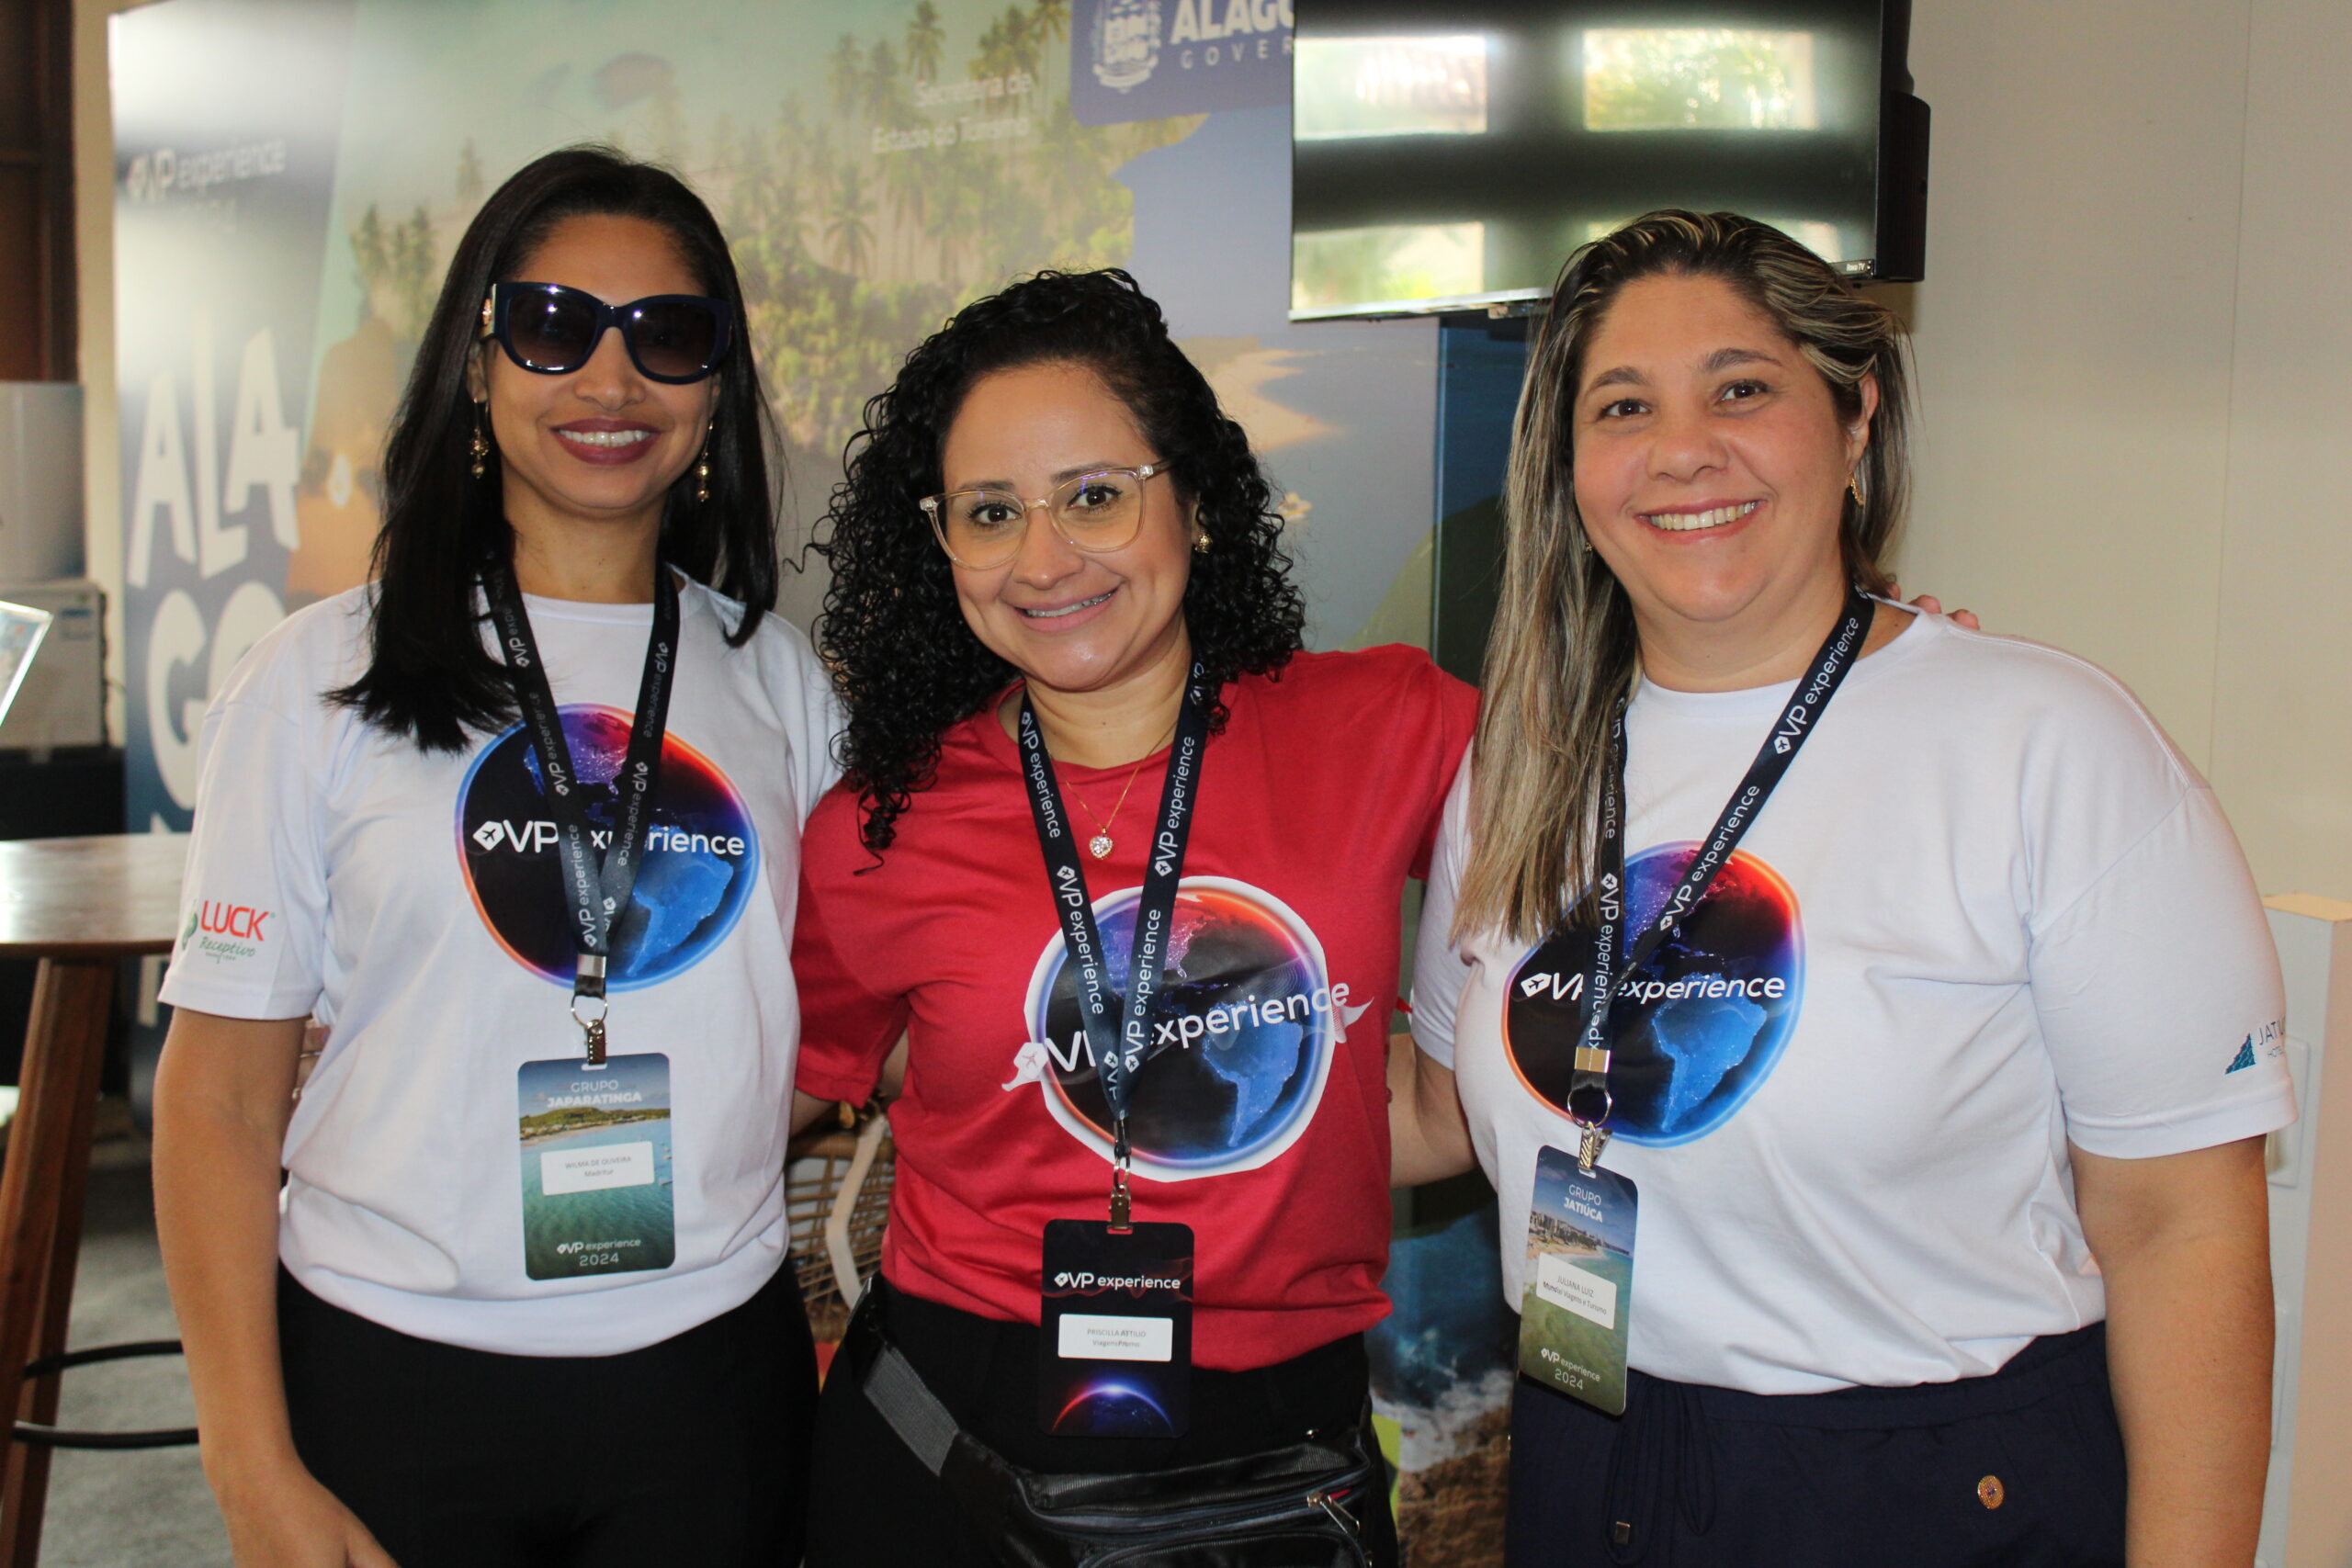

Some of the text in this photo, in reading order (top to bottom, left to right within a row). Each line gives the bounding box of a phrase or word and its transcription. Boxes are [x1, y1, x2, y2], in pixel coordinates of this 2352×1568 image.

[1779, 616, 1859, 737] VP experience
[643, 651, 669, 738] VP experience
[548, 762, 567, 785] VP
[1023, 719, 1060, 838] VP experience
[1157, 736, 1195, 863] VP experience
[617, 770, 649, 866] VP experience
[503, 819, 559, 853] VP
[1666, 784, 1759, 917] VP experience
[568, 824, 596, 935] VP experience
[1600, 888, 1619, 920] VP
[200, 899, 269, 942] LUCK
[199, 935, 256, 960] Receptivo
[1058, 876, 1103, 1014] VP experience
[1125, 909, 1161, 1055] VP experience
[1150, 982, 1351, 1049] xperience
[547, 1091, 642, 1109] JAPARATINGA
[571, 1079, 618, 1093] GRUPO
[591, 1158, 600, 1167] DE
[1564, 1196, 1603, 1223] JATIÚCA
[1568, 1184, 1601, 1206] GRUPO
[565, 1237, 641, 1255] VP experience
[579, 1252, 619, 1267] 2024
[1069, 1272, 1182, 1291] VP experience
[1557, 1274, 1594, 1298] JULIANA LUIZ
[1564, 1290, 1582, 1304] Viagens
[1587, 1300, 1607, 1315] Turismo
[1087, 1328, 1147, 1338] PRISCILLA ATTILIO
[1547, 1349, 1600, 1382] VP experience
[1555, 1368, 1583, 1391] 2024
